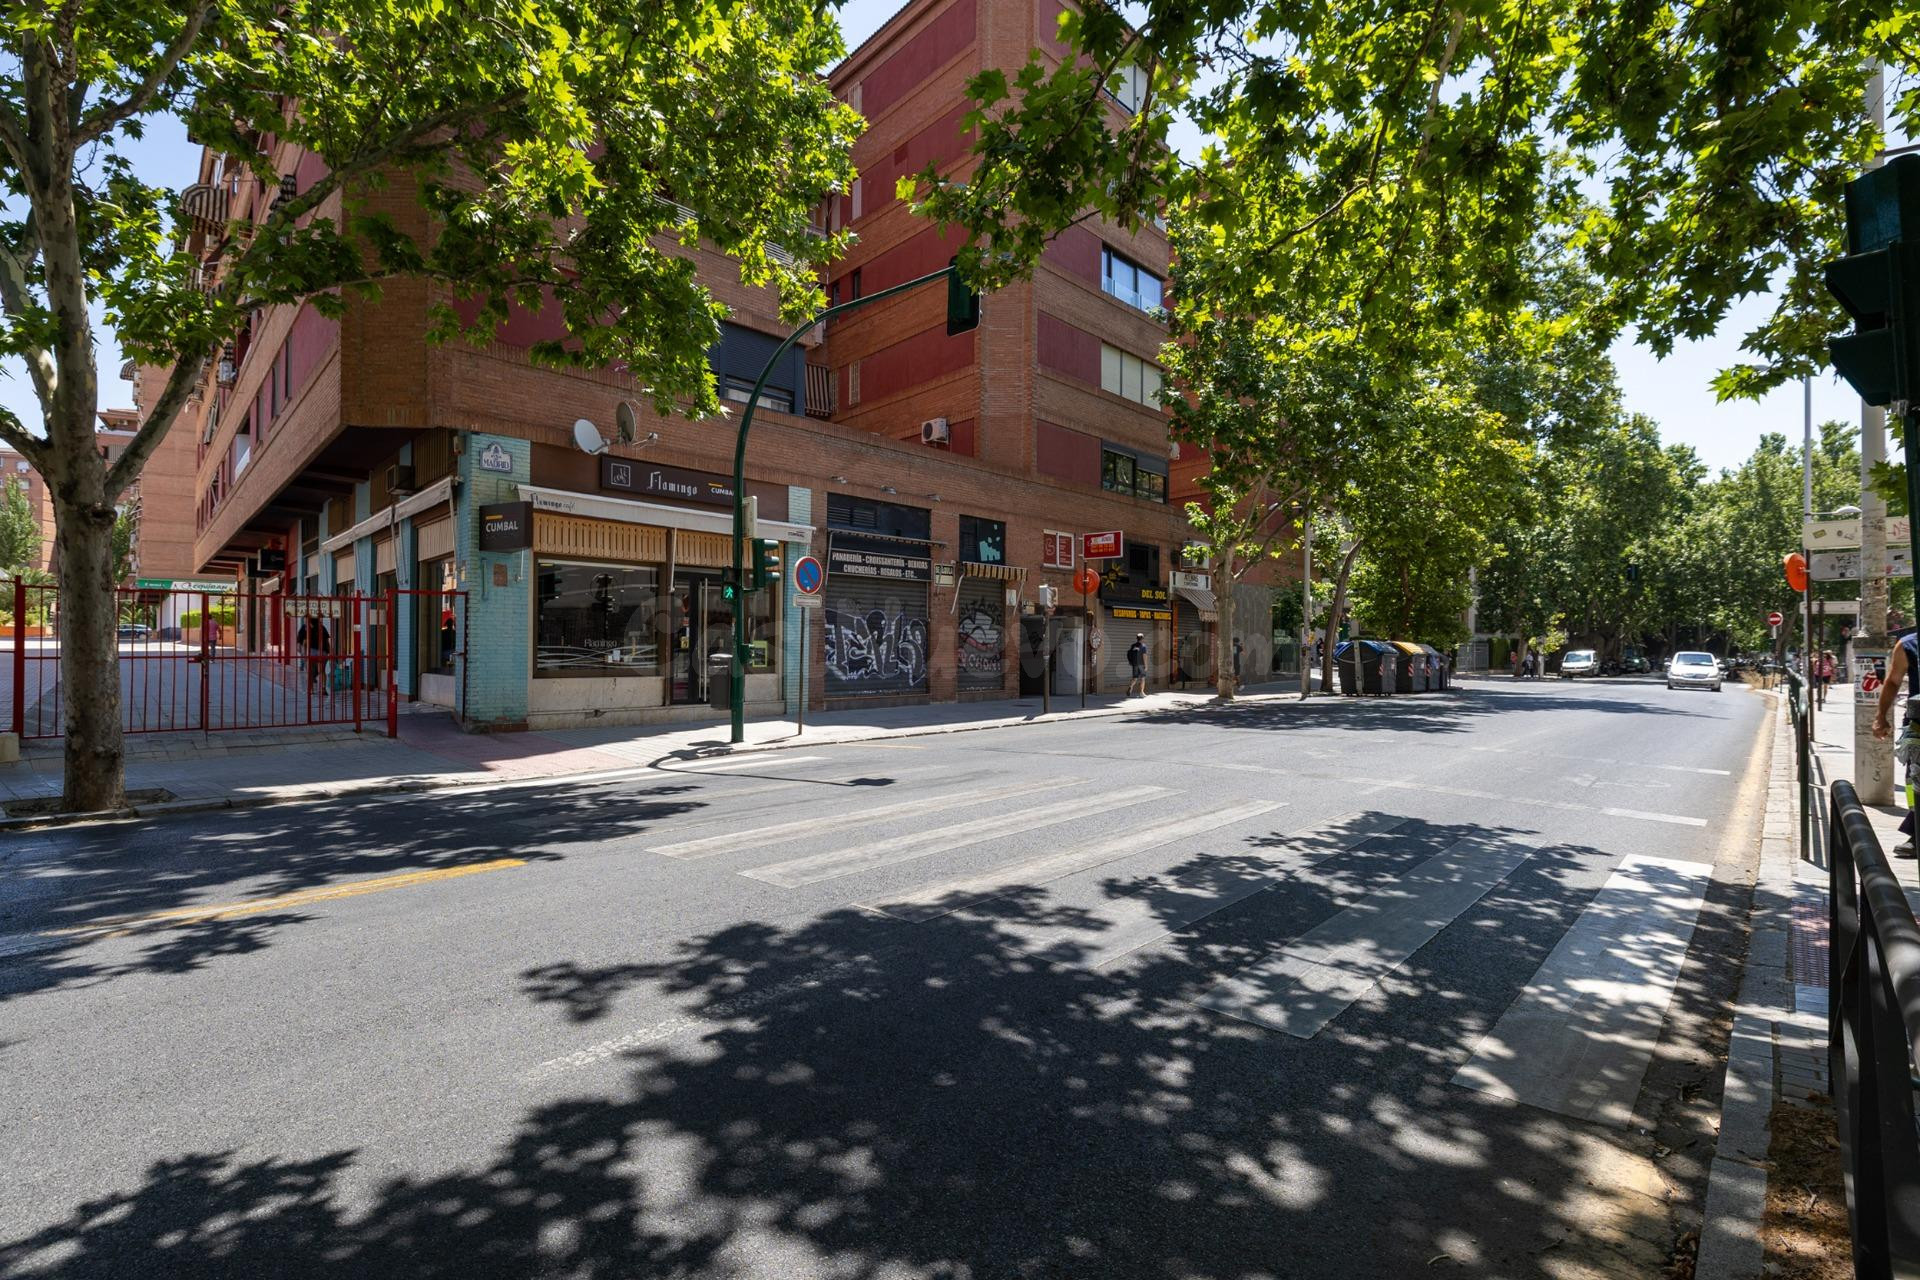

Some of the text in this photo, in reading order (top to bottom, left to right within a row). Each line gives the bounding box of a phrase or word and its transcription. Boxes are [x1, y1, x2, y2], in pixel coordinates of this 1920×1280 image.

[484, 458, 510, 469] MADRID
[647, 471, 698, 496] Flamingo
[711, 488, 735, 497] CUMBA
[485, 520, 518, 533] CUMBAL
[1142, 589, 1166, 600] DEL SOL
